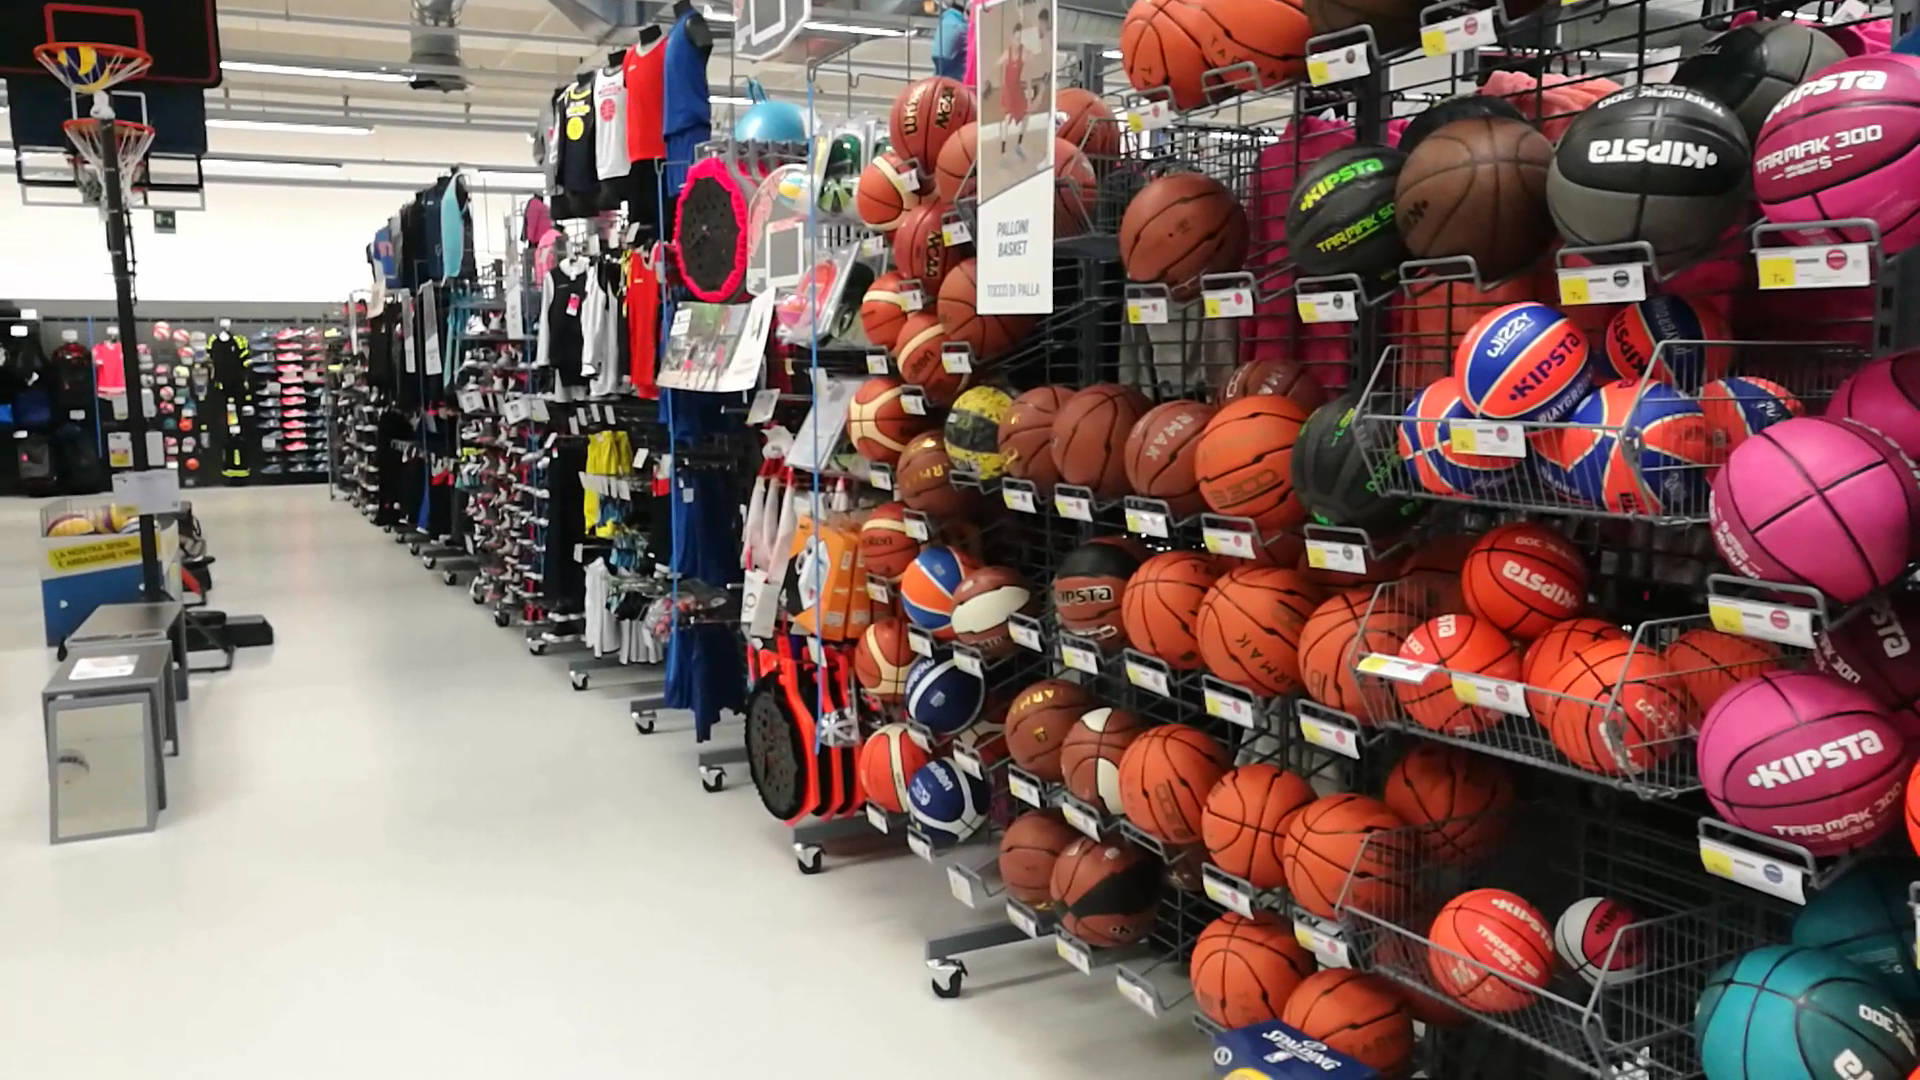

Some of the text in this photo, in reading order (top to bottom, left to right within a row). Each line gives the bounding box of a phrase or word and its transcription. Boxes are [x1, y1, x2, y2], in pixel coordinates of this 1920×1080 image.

[1587, 137, 1719, 170] KIPSTA
[1756, 135, 1831, 174] TARMAK
[1834, 124, 1883, 148] 300
[1299, 157, 1384, 212] KIPSTA
[997, 219, 1029, 236] PALLONI
[1315, 213, 1378, 253] TARMAK
[998, 240, 1027, 257] BASKET
[1018, 283, 1040, 296] PALLA
[1509, 332, 1581, 401] KIPSTA
[1059, 587, 1112, 604] IPSTA
[1748, 729, 1885, 789] KIPSTA
[1772, 806, 1872, 836] TARMAK
[1261, 1029, 1342, 1071] SPALDING
